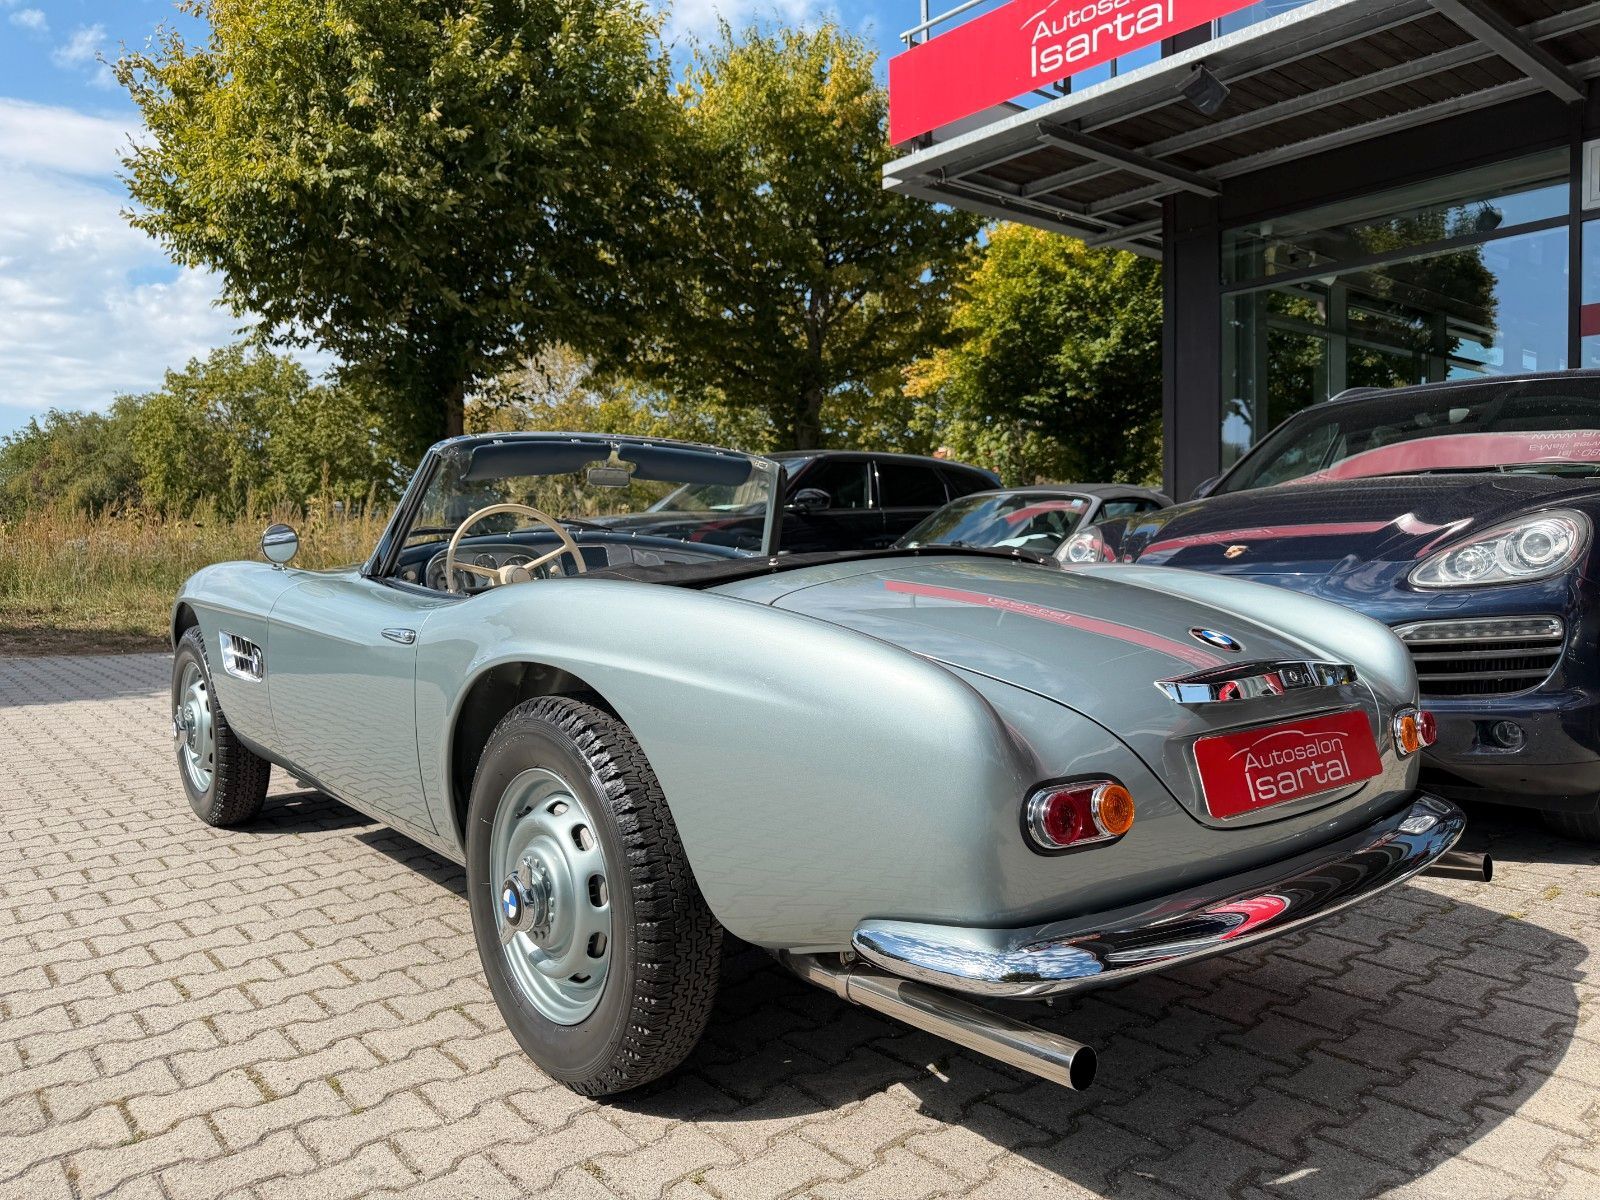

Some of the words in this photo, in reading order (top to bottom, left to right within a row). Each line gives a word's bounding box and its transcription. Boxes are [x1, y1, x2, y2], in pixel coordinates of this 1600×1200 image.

[1031, 0, 1132, 45] Autosa
[1031, 0, 1175, 78] Isartal
[1244, 738, 1343, 772] Autosalon
[1245, 750, 1351, 802] Isartal
